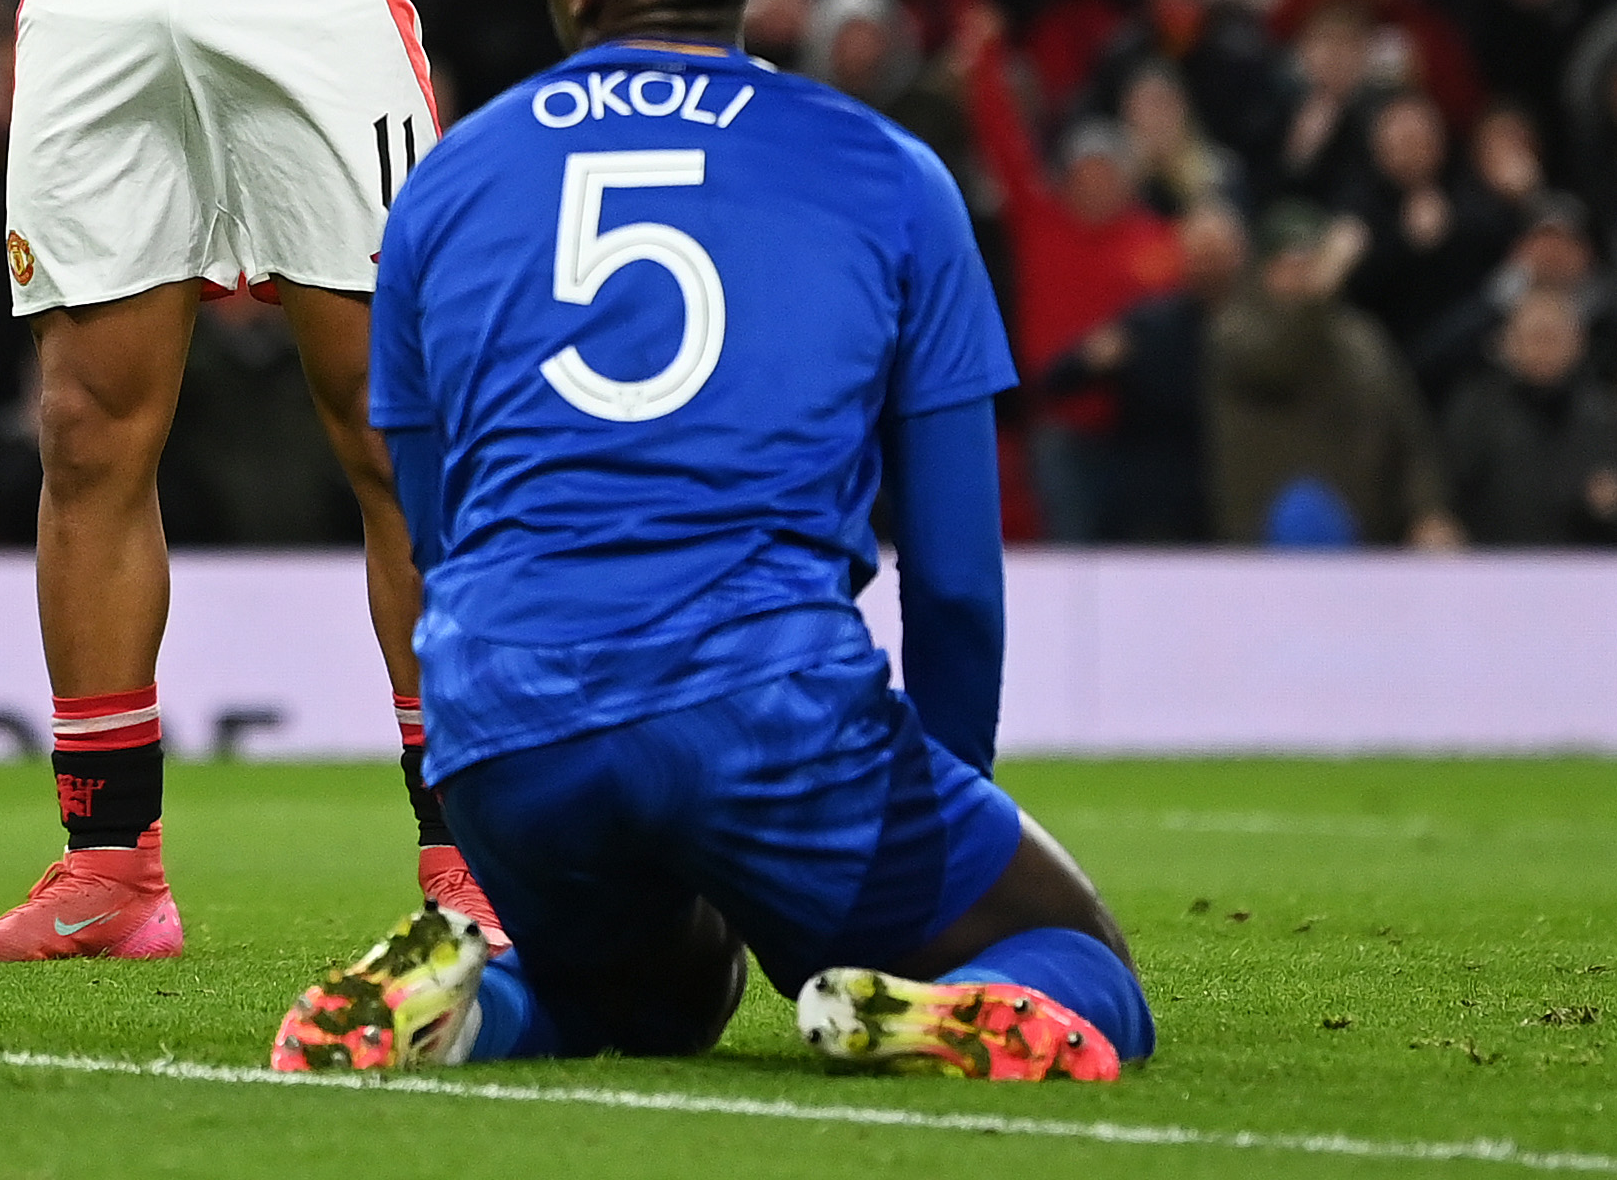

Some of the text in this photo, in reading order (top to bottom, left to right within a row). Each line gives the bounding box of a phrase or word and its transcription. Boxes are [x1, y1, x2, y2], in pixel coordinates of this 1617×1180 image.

[532, 70, 755, 128] OKOLI
[372, 112, 416, 212] 11
[539, 148, 726, 423] 5
